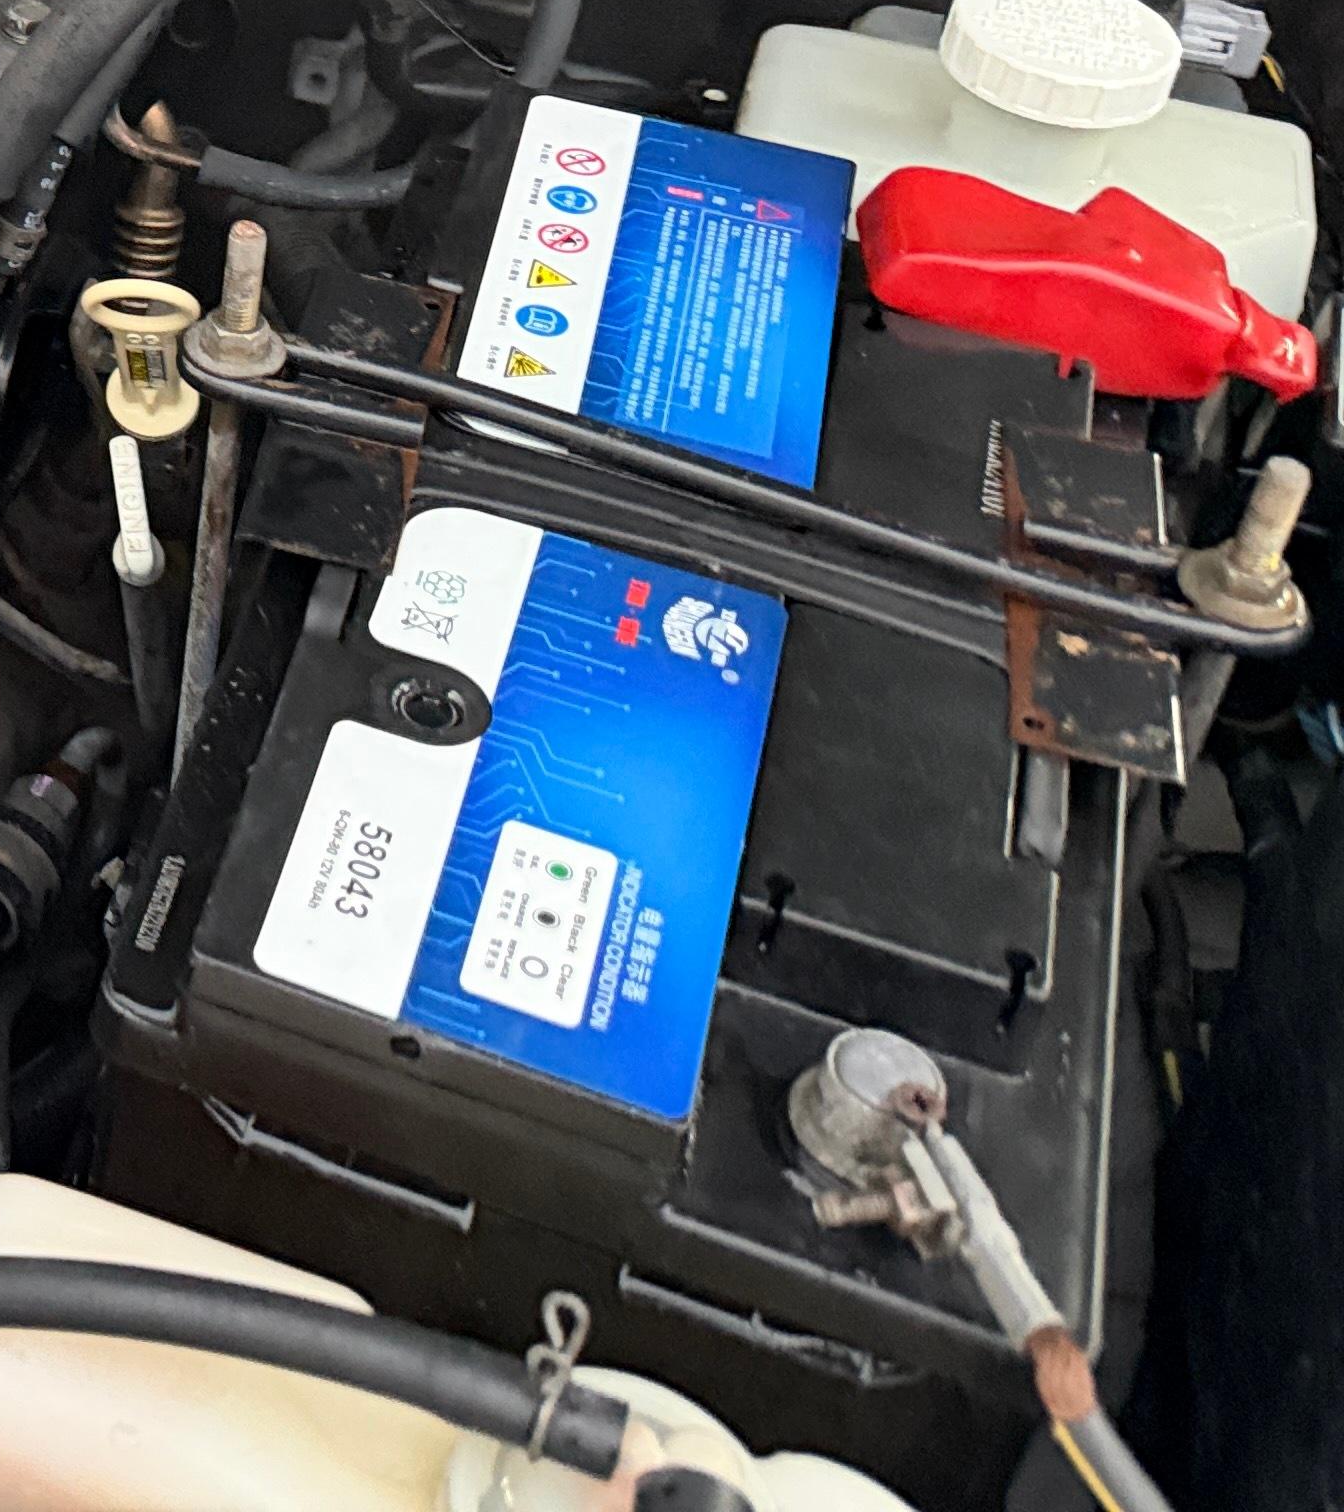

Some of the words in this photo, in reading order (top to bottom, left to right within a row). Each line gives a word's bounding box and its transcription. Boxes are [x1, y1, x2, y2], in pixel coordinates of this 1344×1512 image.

[114, 441, 150, 553] ENGINE
[335, 821, 393, 919] 58043
[579, 866, 598, 904] Green
[566, 914, 586, 954] Black
[555, 963, 574, 1001] Clear
